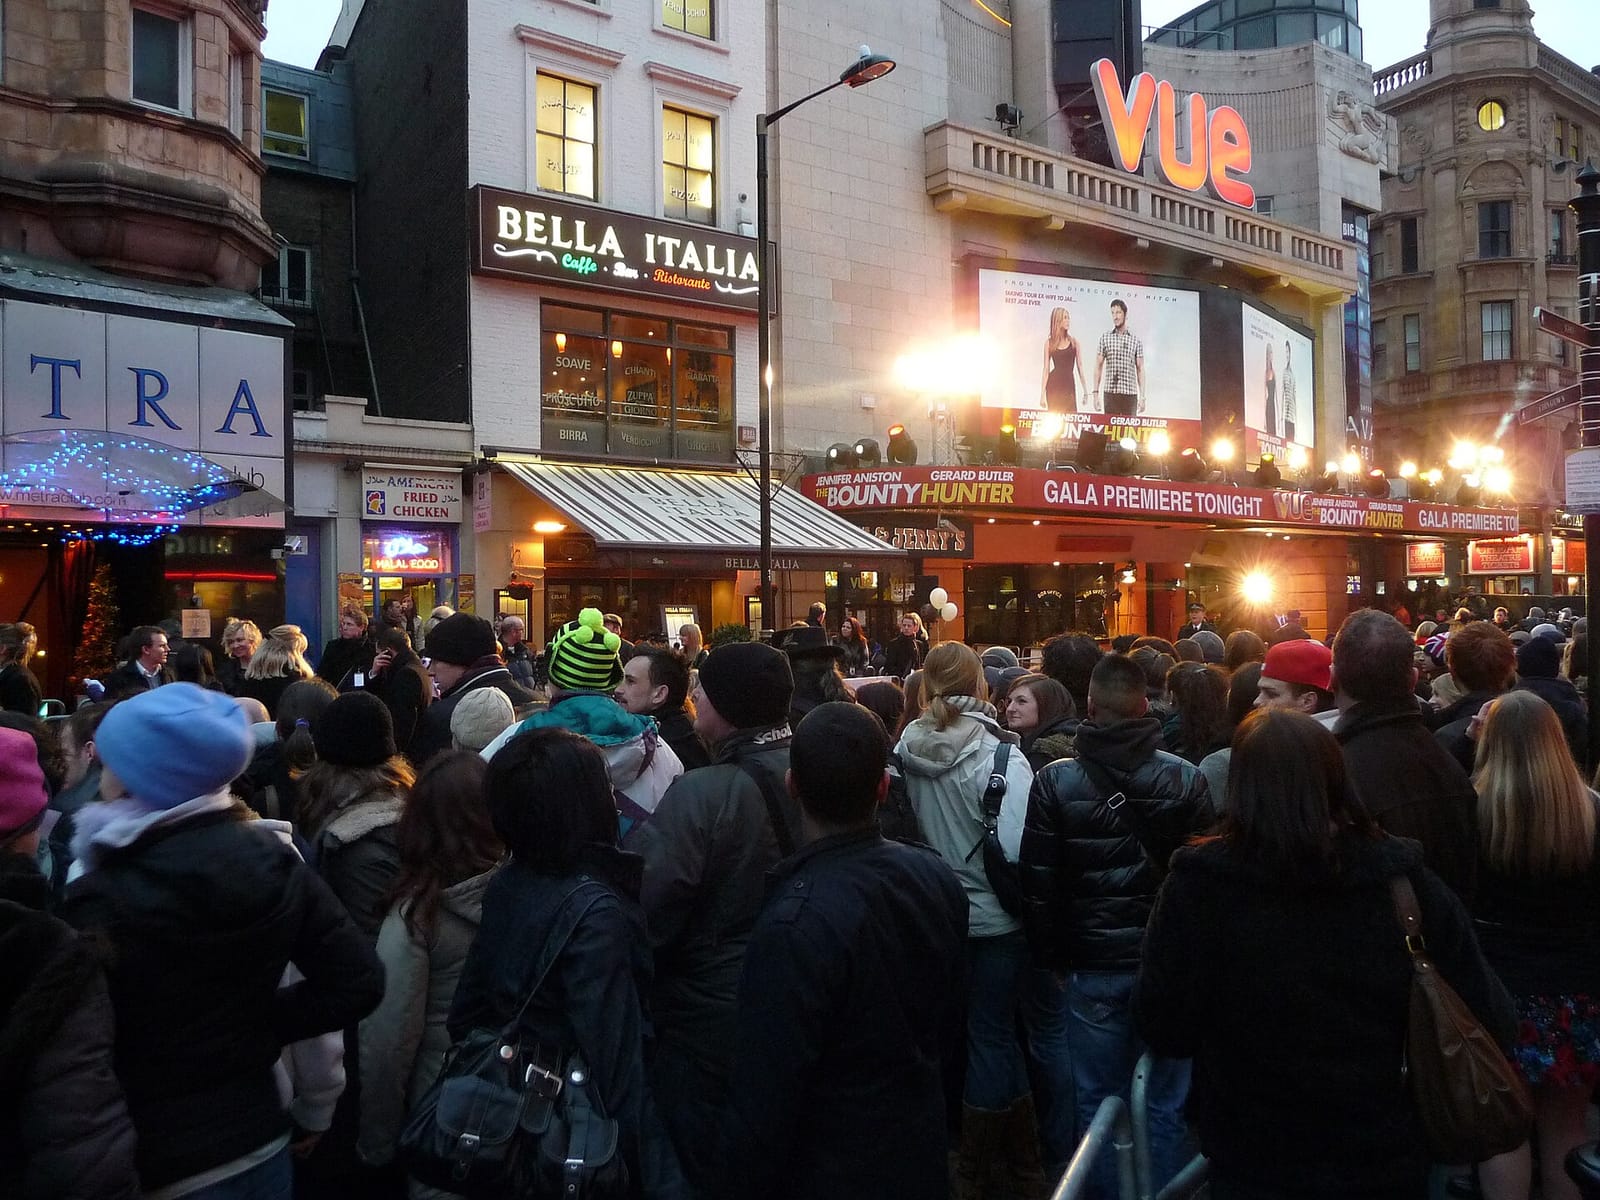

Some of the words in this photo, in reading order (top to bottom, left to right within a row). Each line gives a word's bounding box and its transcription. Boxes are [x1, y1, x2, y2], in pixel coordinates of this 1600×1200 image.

[1342, 222, 1355, 237] BIG
[497, 205, 625, 259] BELLA
[645, 232, 760, 282] ITALIA
[653, 268, 712, 290] Ristorante
[1004, 279, 1034, 288] FROM
[1067, 286, 1120, 296] DIRECTOR
[1145, 294, 1178, 303] HITCH
[556, 356, 592, 371] SOAVE
[624, 366, 657, 378] CHIANTI
[626, 390, 655, 404] ZUPPA
[624, 405, 658, 418] GIORNO
[1017, 420, 1033, 429] THE
[1110, 416, 1141, 427] GERARD
[1141, 418, 1168, 428] BUTLER
[559, 429, 588, 442] BIRRA
[815, 474, 852, 487] JENNIFER
[853, 471, 902, 484] ANISTON
[930, 470, 976, 482] GERARD
[977, 470, 1014, 482] BUTLER
[403, 491, 438, 503] FRIED
[815, 488, 829, 498] THE
[827, 482, 922, 507] BOUNTY
[920, 482, 1015, 505] HUNTER
[1043, 478, 1099, 506] GALA
[1102, 484, 1193, 513] PREMIERE
[1194, 491, 1263, 517] TONIGHT
[1311, 497, 1335, 507] JENNIFER
[1334, 500, 1358, 509] ANISTON
[1368, 502, 1387, 511] GERARD
[1387, 503, 1404, 512] BUTLER
[393, 505, 449, 518] CHICKEN
[1320, 507, 1366, 526] BOUNTY
[1364, 511, 1404, 529] HUNTER
[1418, 509, 1449, 528] GALA
[1451, 511, 1503, 531] PREMIERE
[892, 527, 966, 552] JERRY'S
[375, 558, 409, 569] HALAL
[725, 558, 760, 569] BELLA
[770, 559, 800, 569] TALIA
